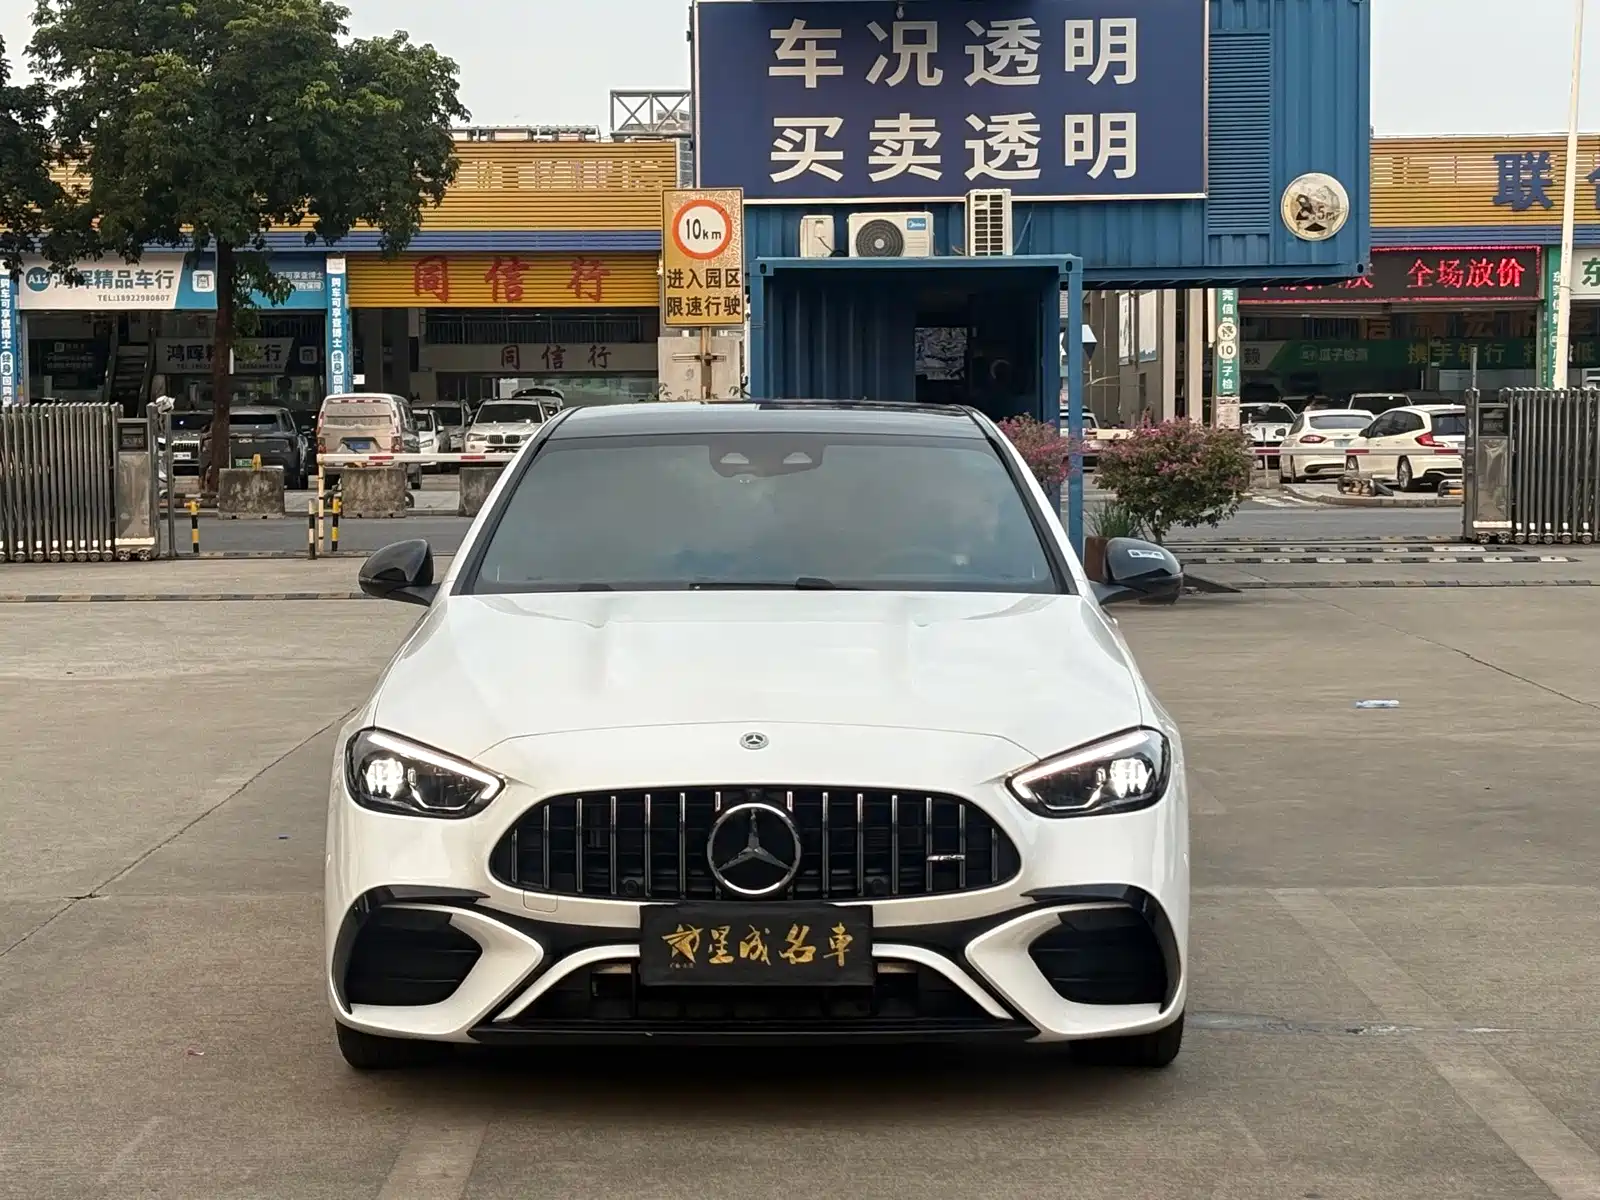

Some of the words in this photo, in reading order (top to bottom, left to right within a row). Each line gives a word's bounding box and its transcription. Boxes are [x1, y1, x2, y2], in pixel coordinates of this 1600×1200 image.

[768, 17, 1137, 89] 车况透明
[769, 112, 1137, 182] 买卖透明
[686, 218, 722, 240] 10km
[414, 256, 611, 304] 同信行
[667, 268, 741, 289] 进入园区
[1407, 257, 1526, 288] 全场放价
[667, 295, 741, 317] 限速行驶
[500, 344, 612, 371] 同信行
[1221, 345, 1234, 356] 10
